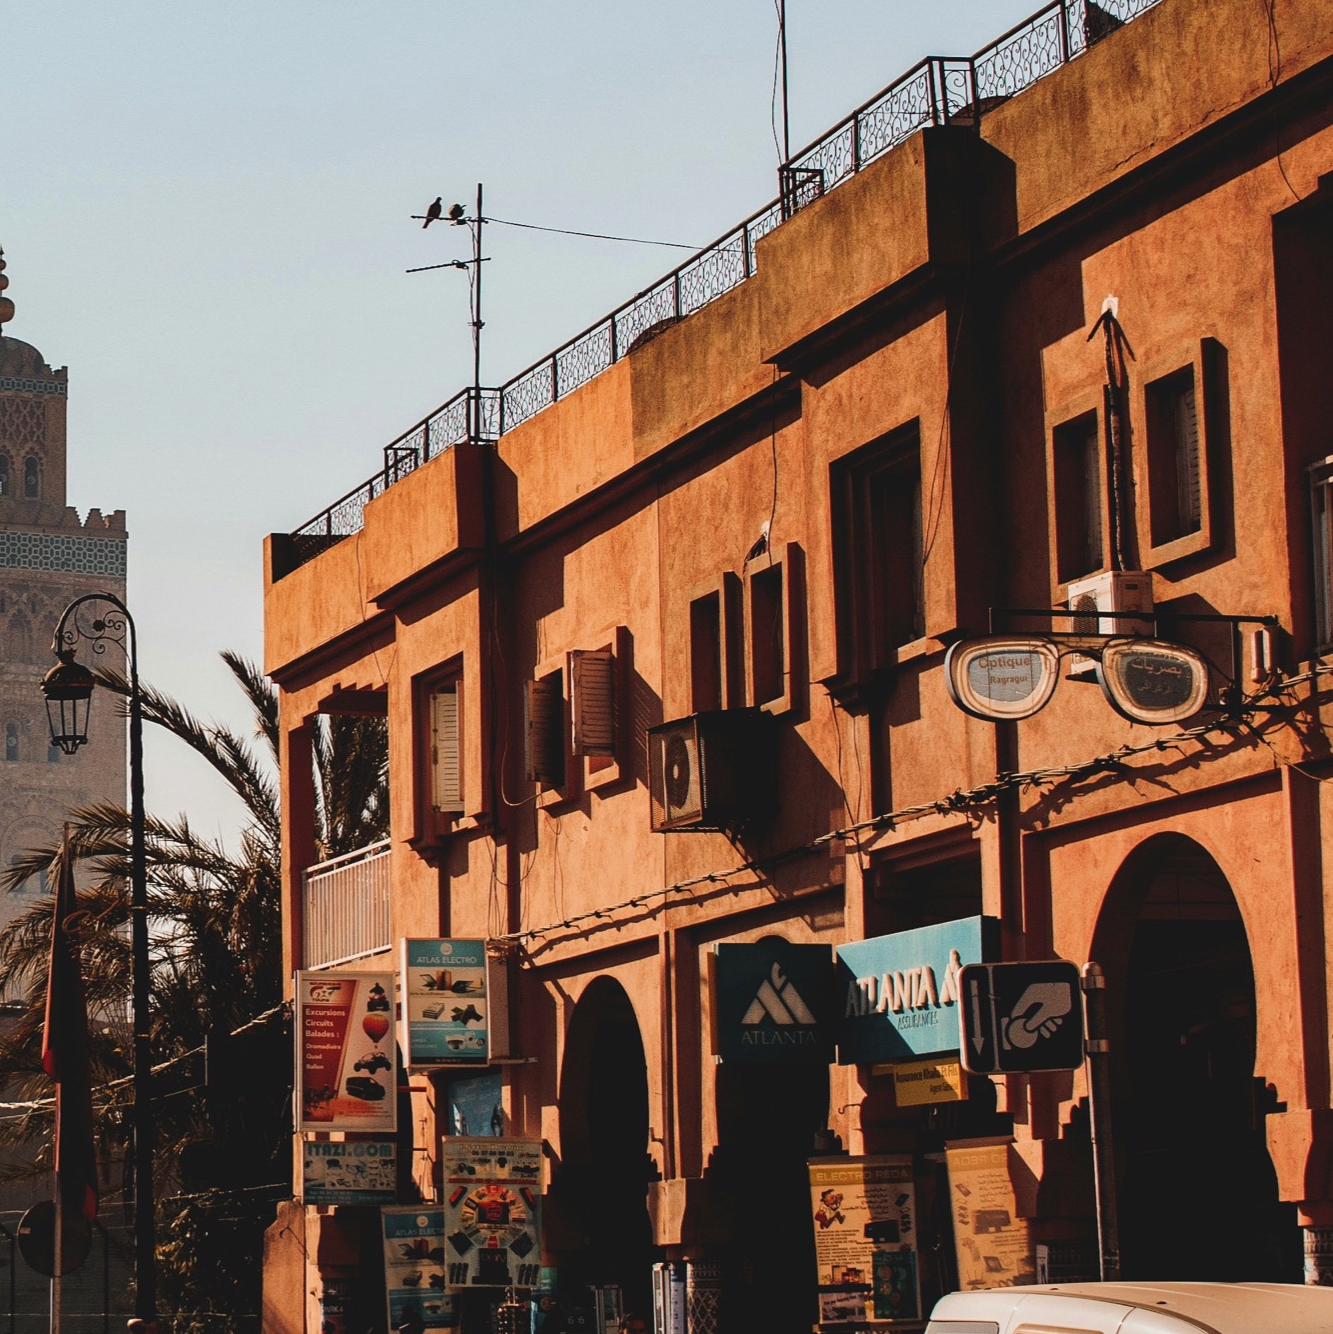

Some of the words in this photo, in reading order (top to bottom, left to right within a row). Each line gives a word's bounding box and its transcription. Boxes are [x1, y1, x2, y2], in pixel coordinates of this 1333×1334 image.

[978, 656, 1031, 670] Optique
[1131, 657, 1182, 678] بصريات
[416, 956, 440, 964] ATLAS
[442, 956, 477, 964] ELECTRO
[845, 965, 940, 1018] ATLANTA
[305, 1008, 346, 1017] Excursions
[305, 1019, 334, 1027] Circuits
[897, 1011, 939, 1030] ASSURANCES
[305, 1029, 335, 1038] Balades
[741, 1030, 817, 1045] ATLANTA
[816, 1170, 873, 1181] ELECTRO
[875, 1169, 908, 1179] REDA
[395, 1228, 417, 1236] ATLAS
[418, 1227, 444, 1235] ELECT
